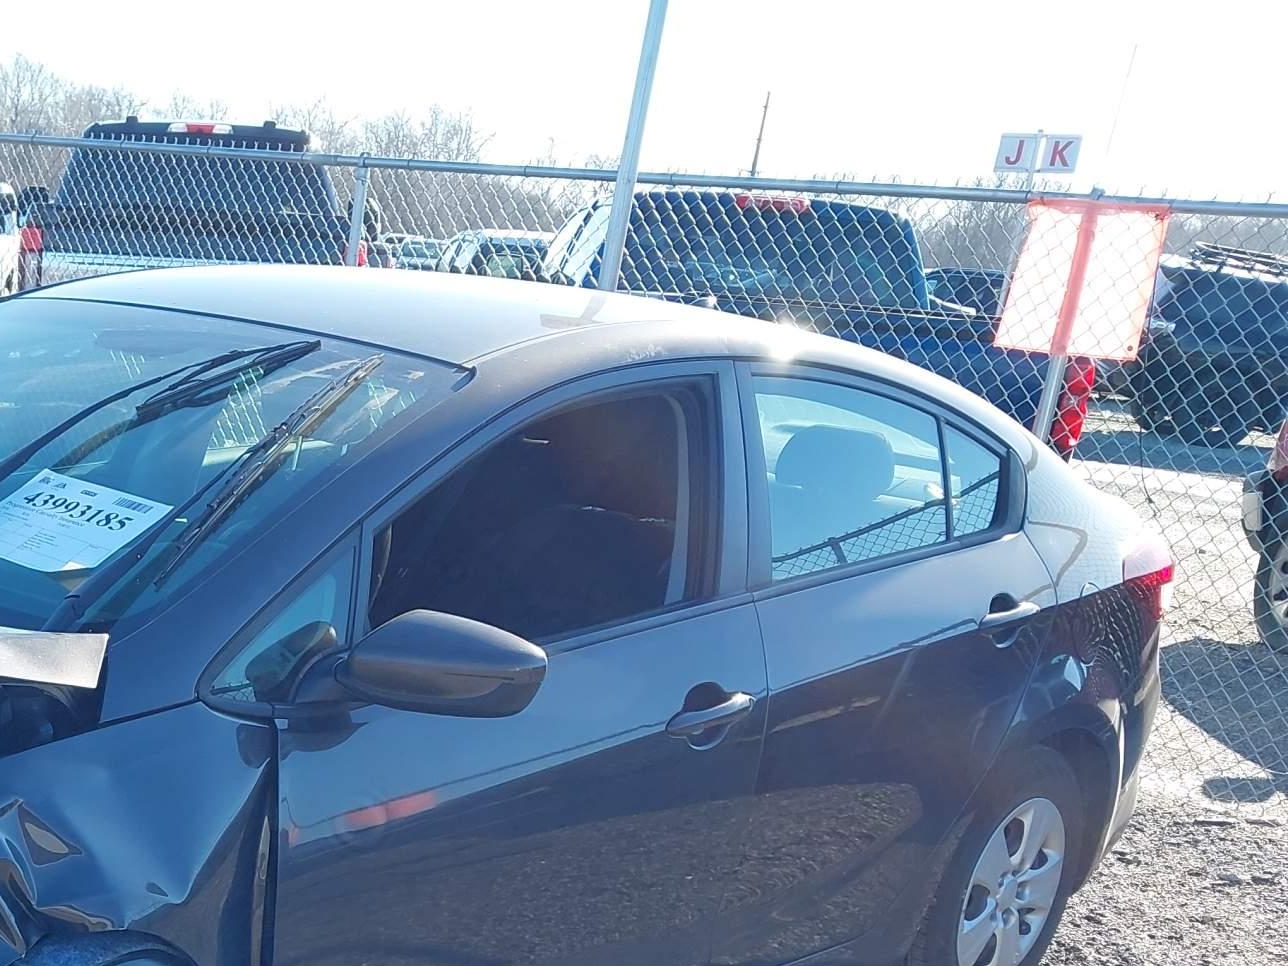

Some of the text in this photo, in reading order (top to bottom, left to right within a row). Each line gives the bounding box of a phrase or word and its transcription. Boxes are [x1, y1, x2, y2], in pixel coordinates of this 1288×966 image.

[1005, 140, 1074, 167] J K
[24, 491, 134, 530] 43993185
